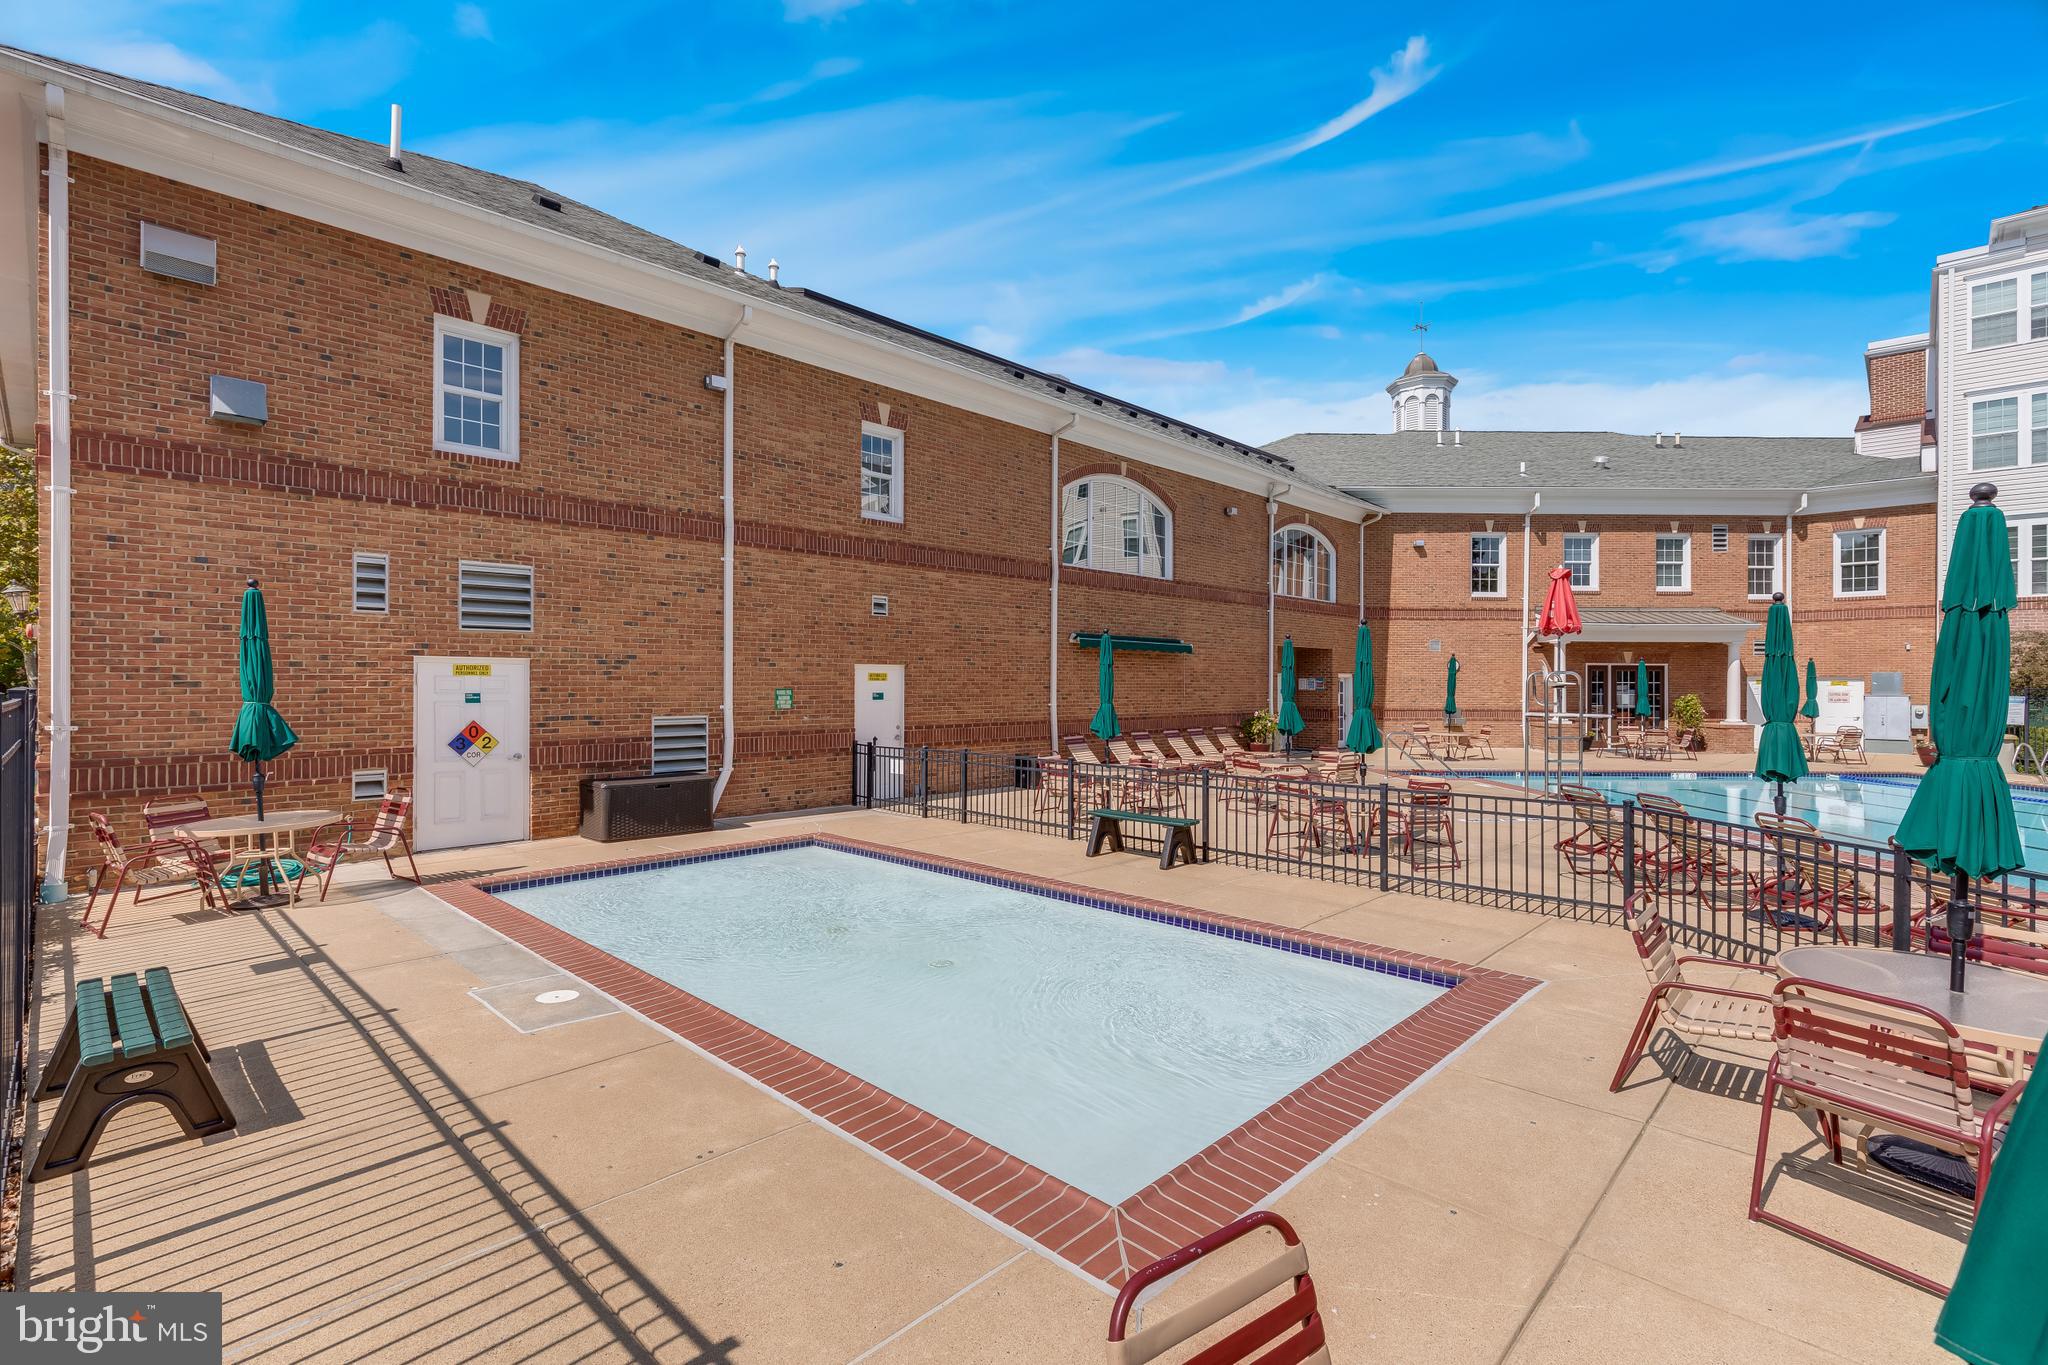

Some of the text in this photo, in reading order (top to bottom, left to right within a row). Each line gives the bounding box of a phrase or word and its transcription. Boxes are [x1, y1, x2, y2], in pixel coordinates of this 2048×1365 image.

[468, 726, 478, 738] 0
[456, 738, 465, 750] 3
[482, 736, 492, 748] 2
